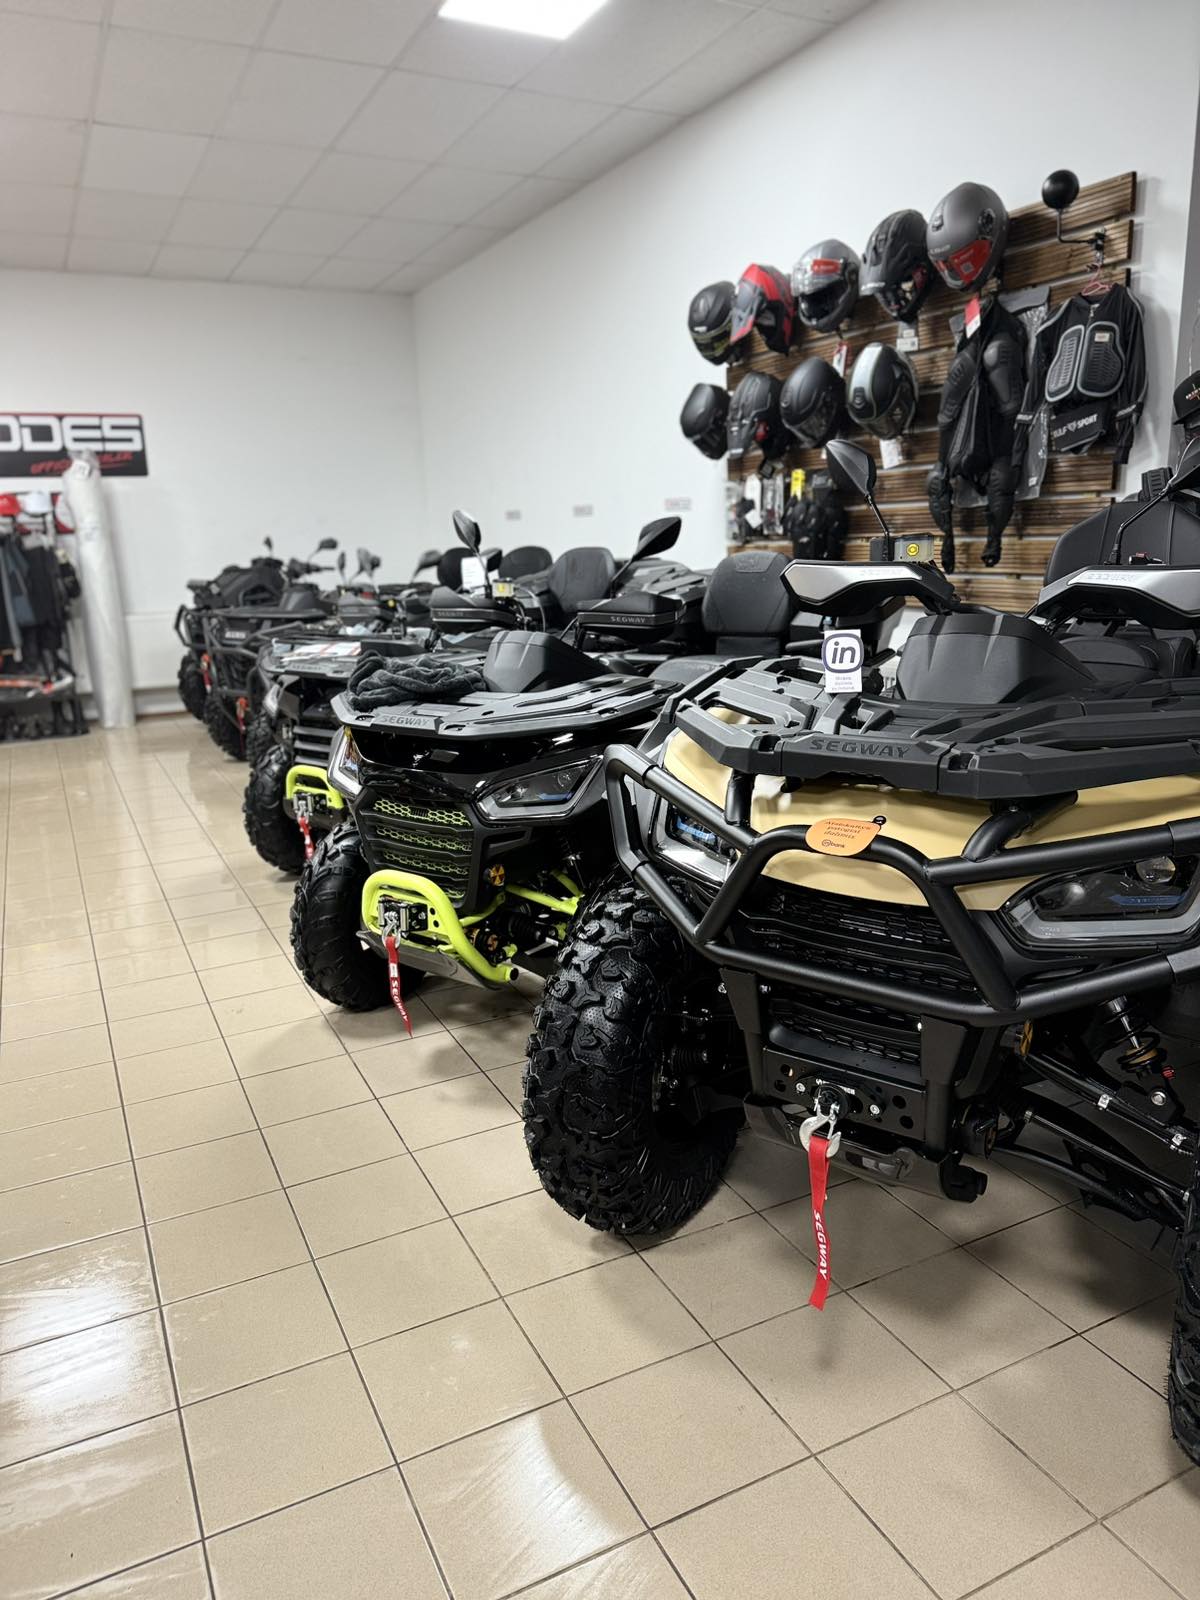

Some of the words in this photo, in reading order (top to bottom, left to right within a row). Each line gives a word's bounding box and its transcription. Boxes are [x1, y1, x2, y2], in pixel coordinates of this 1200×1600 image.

[1077, 413, 1098, 429] SPORT
[610, 615, 646, 624] SEGWAY
[831, 641, 856, 664] in
[380, 714, 430, 726] SEGWAY
[809, 739, 909, 758] SEGWAY
[391, 980, 409, 1021] SEGWAY
[813, 1209, 828, 1280] SEGWAY
